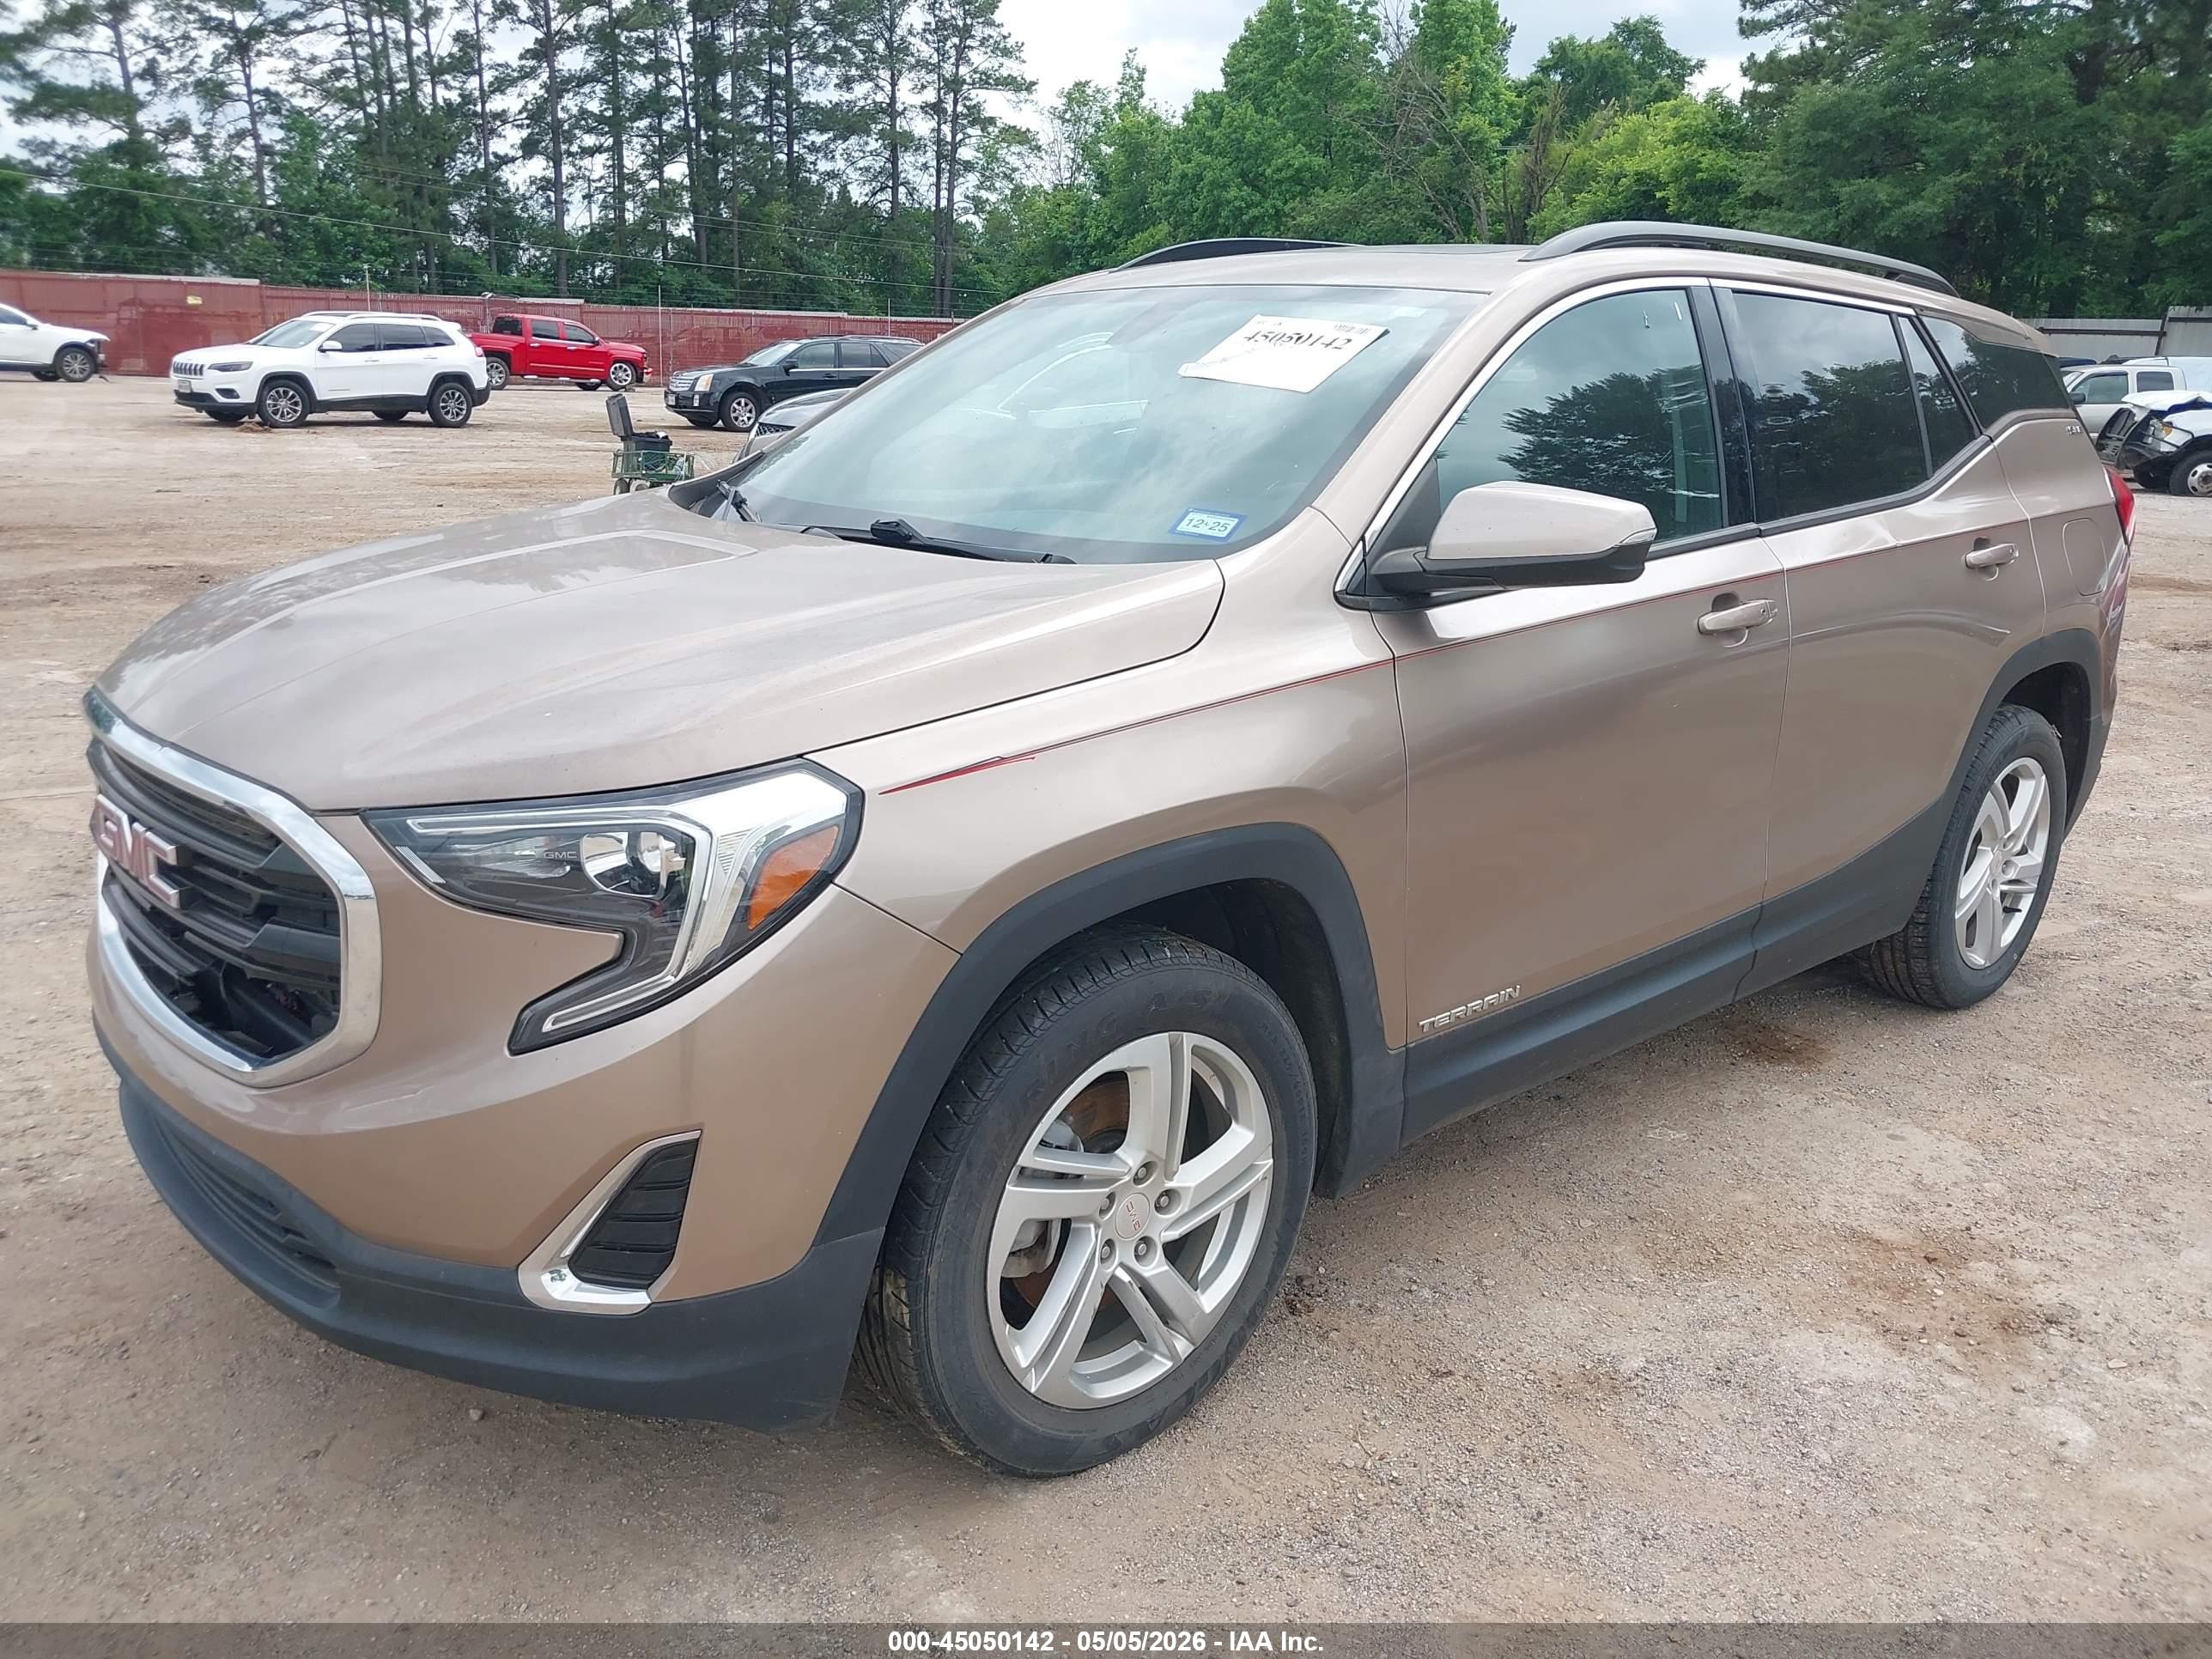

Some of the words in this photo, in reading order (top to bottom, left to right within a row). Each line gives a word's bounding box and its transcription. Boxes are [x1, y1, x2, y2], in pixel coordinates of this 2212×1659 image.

[89, 793, 180, 908] GMC
[543, 850, 578, 859] GMC
[1419, 984, 1521, 1032] TERRAIN
[1126, 1200, 1141, 1231] GMC
